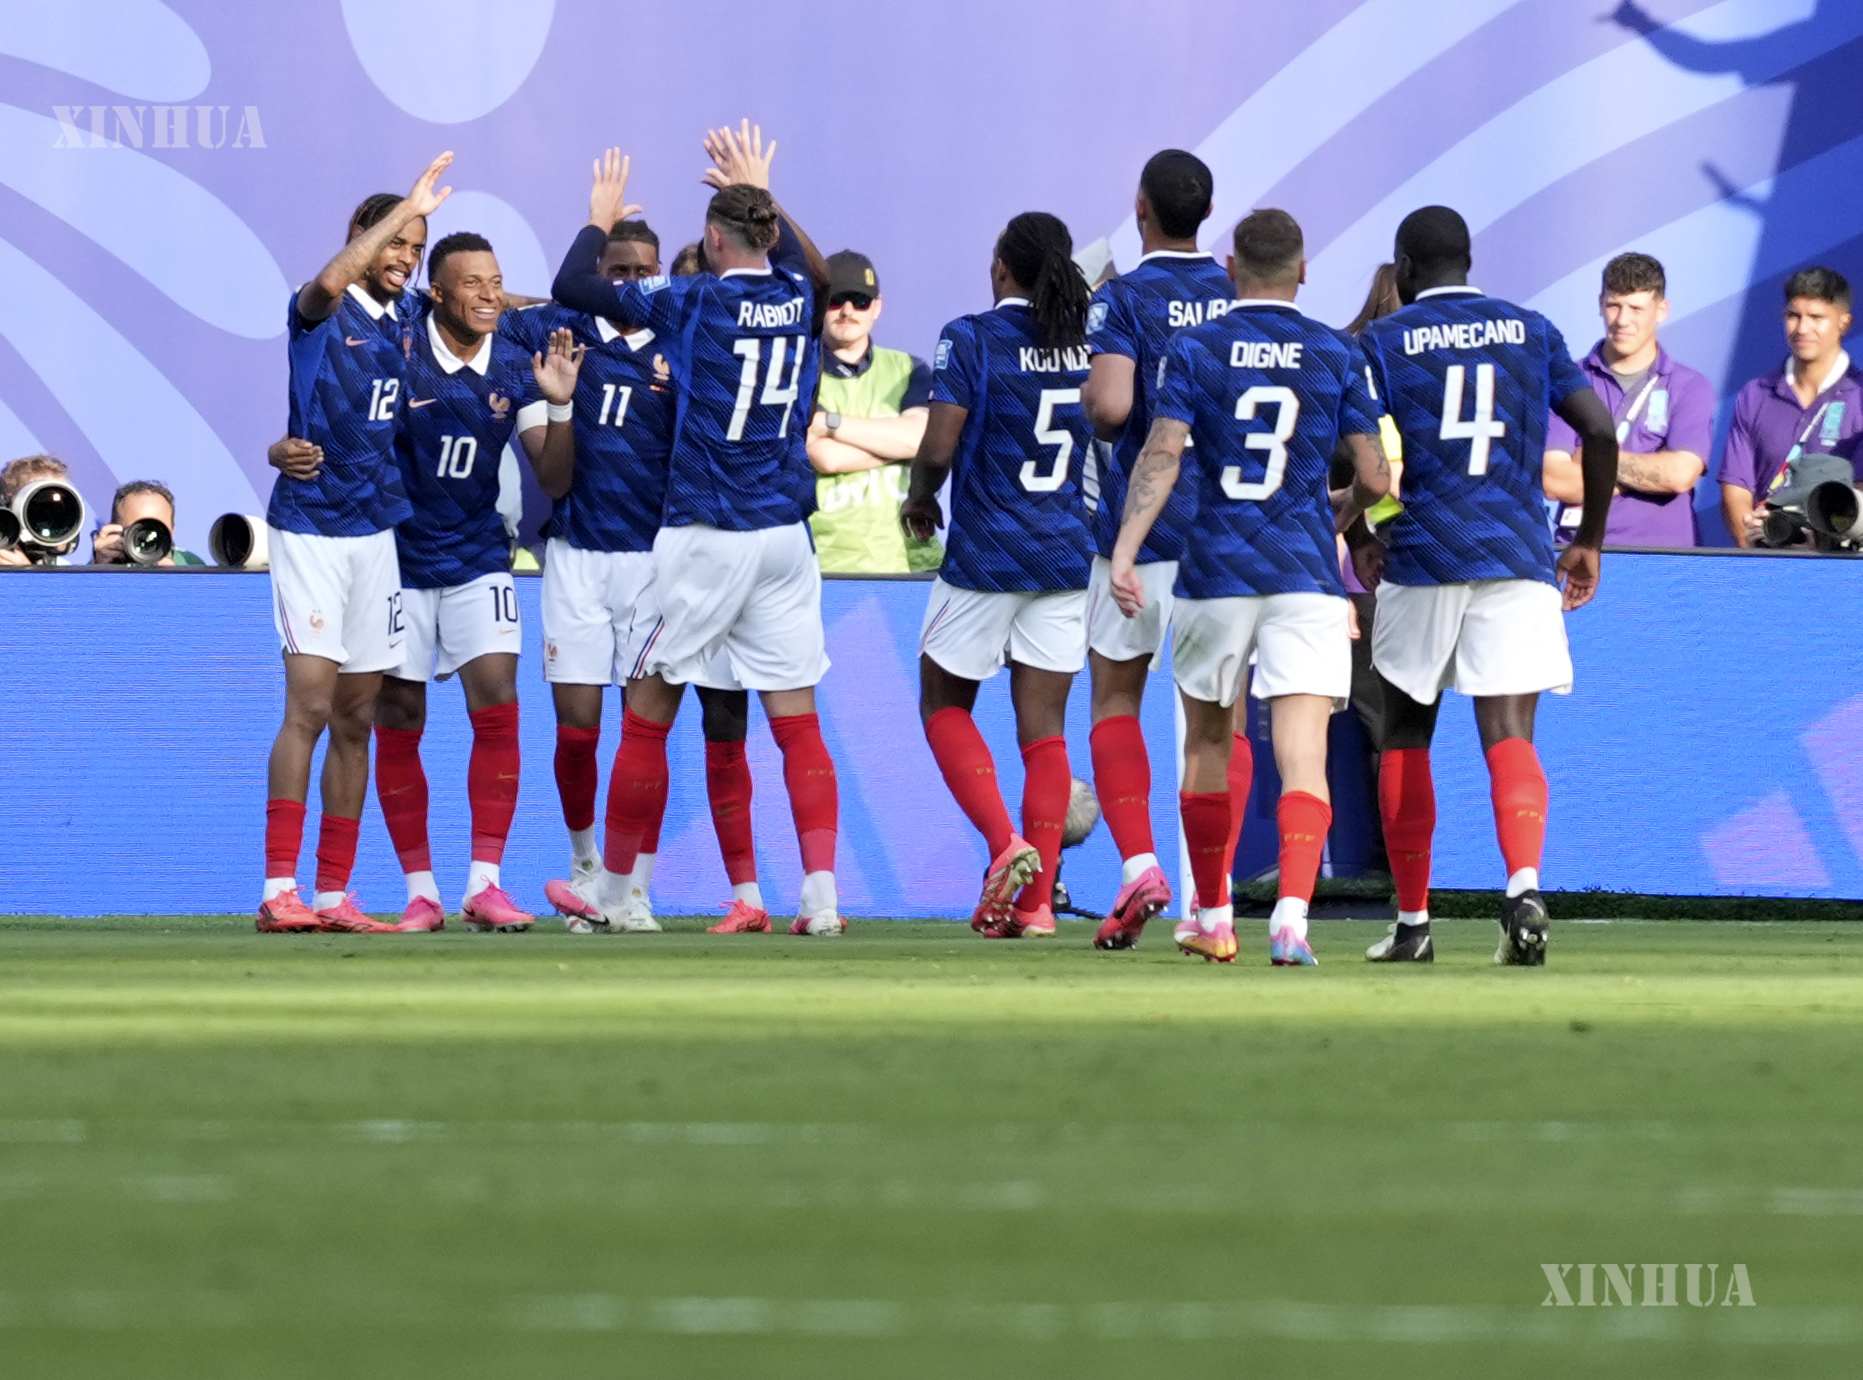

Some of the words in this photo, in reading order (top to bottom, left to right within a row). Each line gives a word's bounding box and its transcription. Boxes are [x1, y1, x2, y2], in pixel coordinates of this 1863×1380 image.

[737, 297, 804, 328] RABIOT
[1230, 341, 1303, 368] DIGNE
[1404, 319, 1525, 355] UPAMECANO
[368, 378, 399, 420] 12
[598, 383, 632, 427] 11
[726, 335, 805, 441] 14
[1019, 388, 1081, 491] 5
[1439, 363, 1505, 475] 4
[437, 435, 477, 478] 10
[1220, 386, 1299, 500] 3
[387, 591, 404, 635] 12
[489, 585, 518, 622] 10
